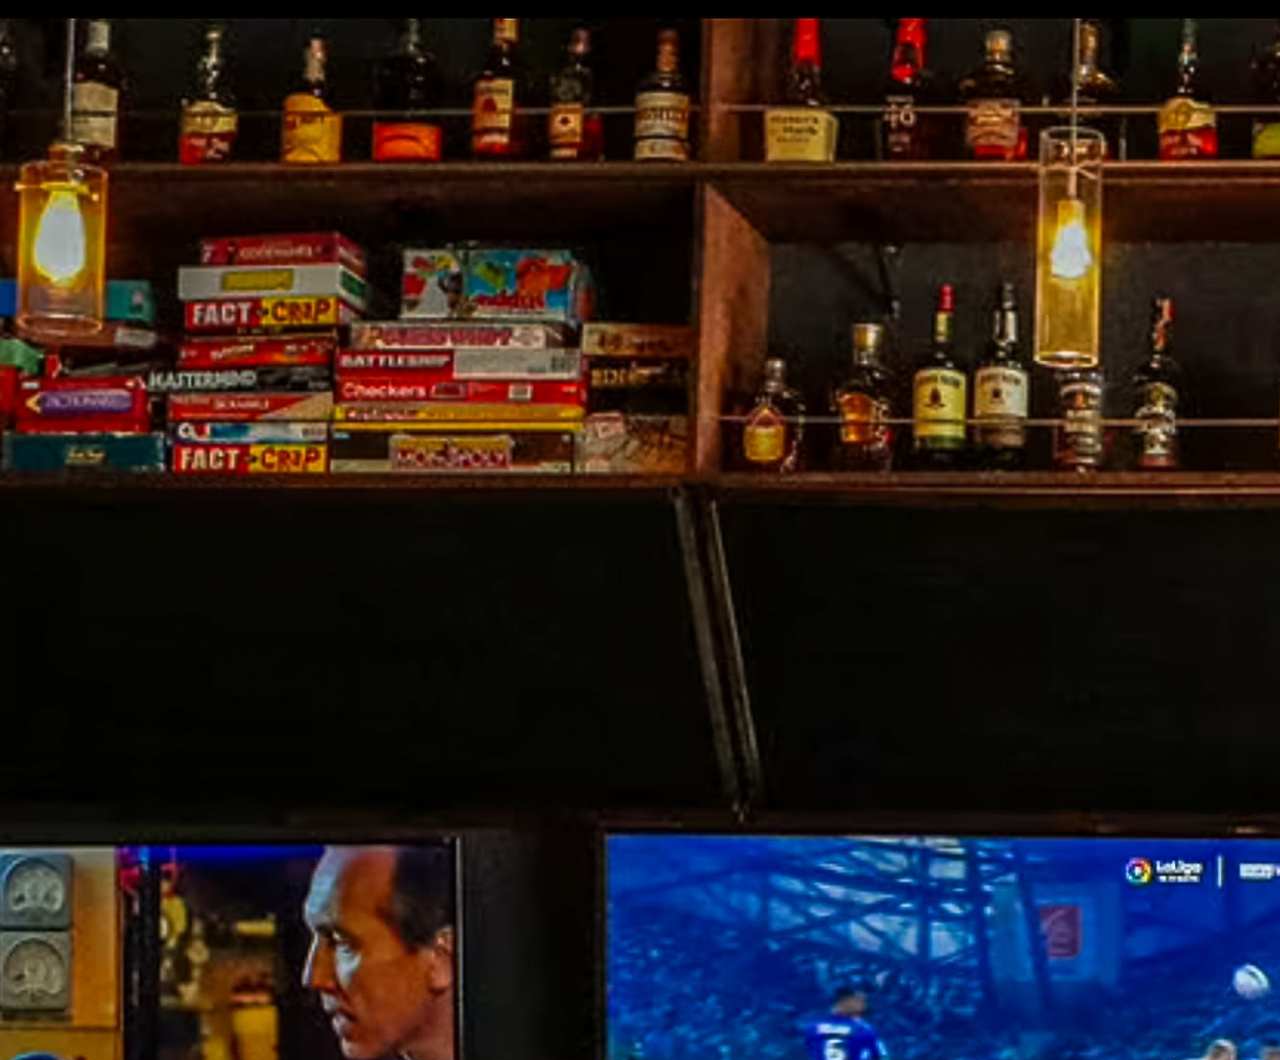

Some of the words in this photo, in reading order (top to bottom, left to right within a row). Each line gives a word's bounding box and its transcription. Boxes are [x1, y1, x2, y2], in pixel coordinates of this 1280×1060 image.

[193, 302, 252, 325] FACT
[340, 354, 450, 369] BATTLESHIP
[149, 369, 258, 392] MASTERMIND
[341, 381, 427, 400] Checkers
[180, 447, 240, 470] FACT
